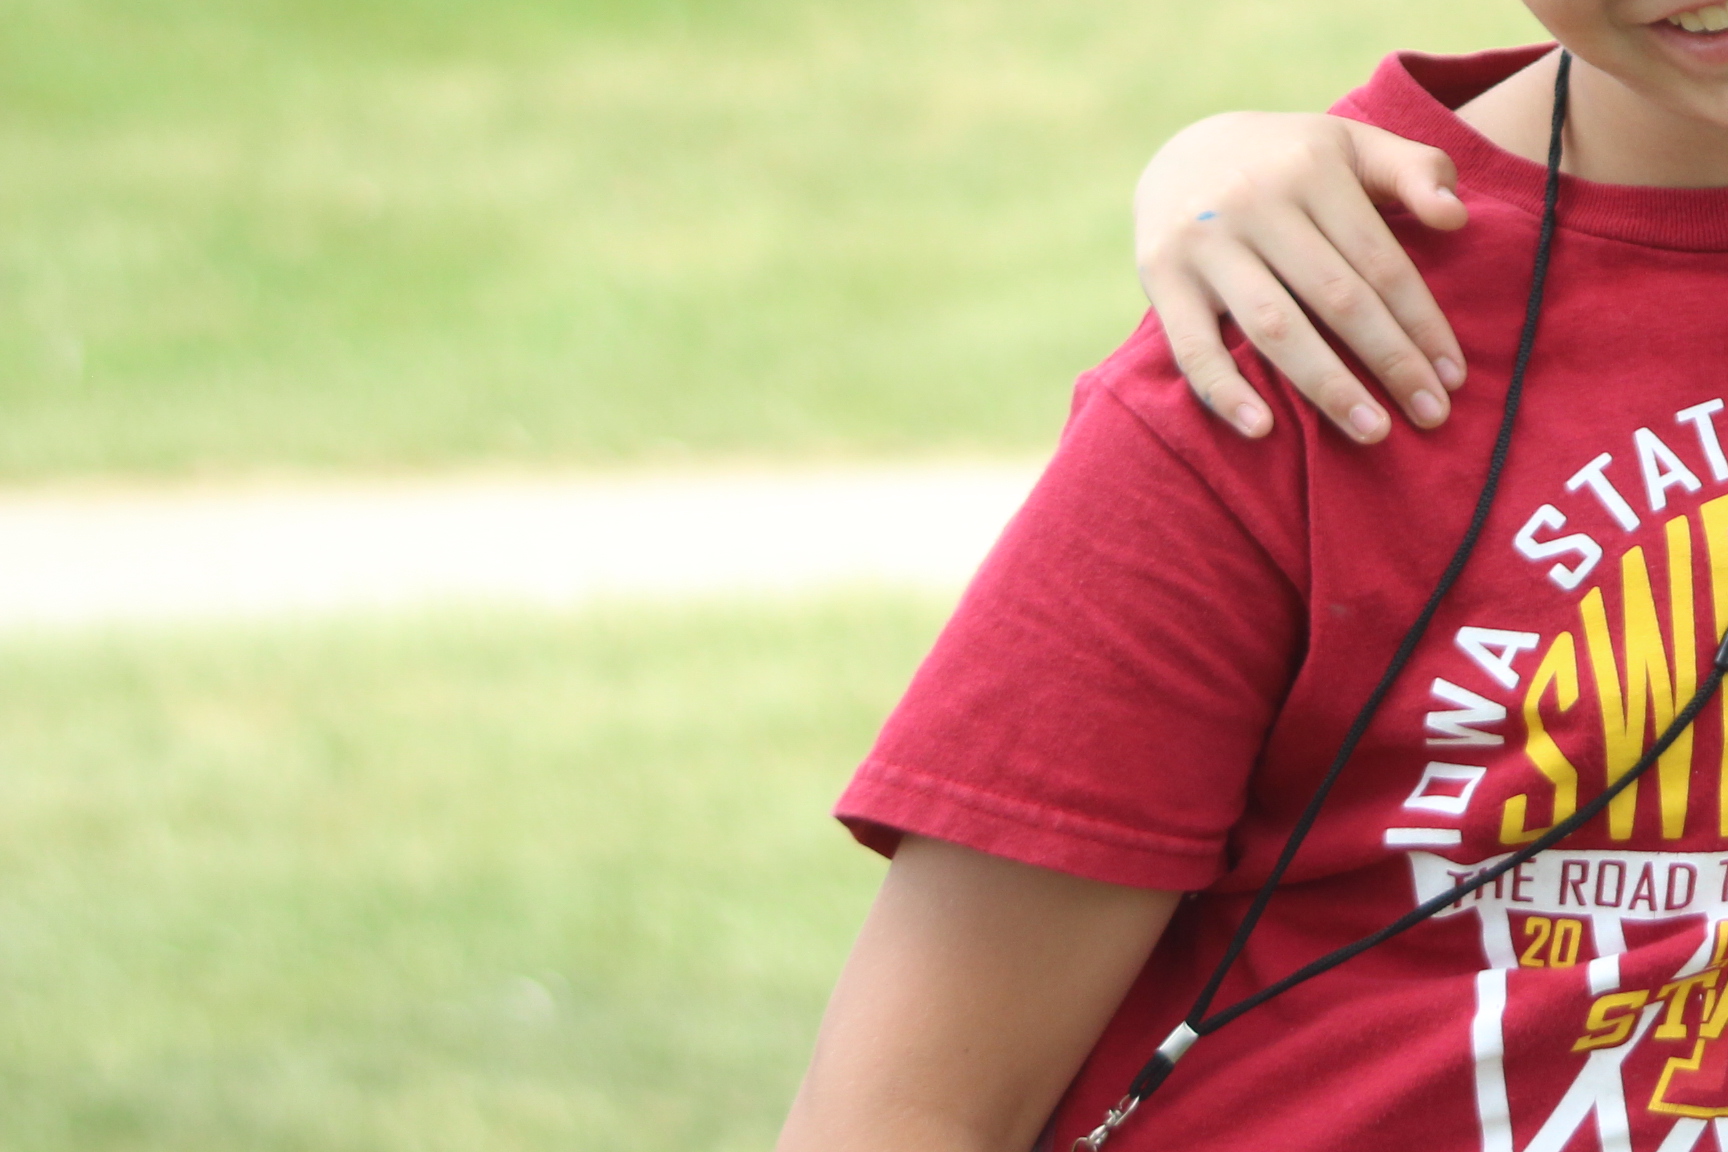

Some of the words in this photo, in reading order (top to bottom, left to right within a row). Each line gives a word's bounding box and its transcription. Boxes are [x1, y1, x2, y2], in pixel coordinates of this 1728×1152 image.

[1384, 626, 1540, 845] IOWA
[1446, 856, 1539, 909] THE
[1559, 858, 1698, 912] ROAD
[1520, 916, 1583, 968] 20
